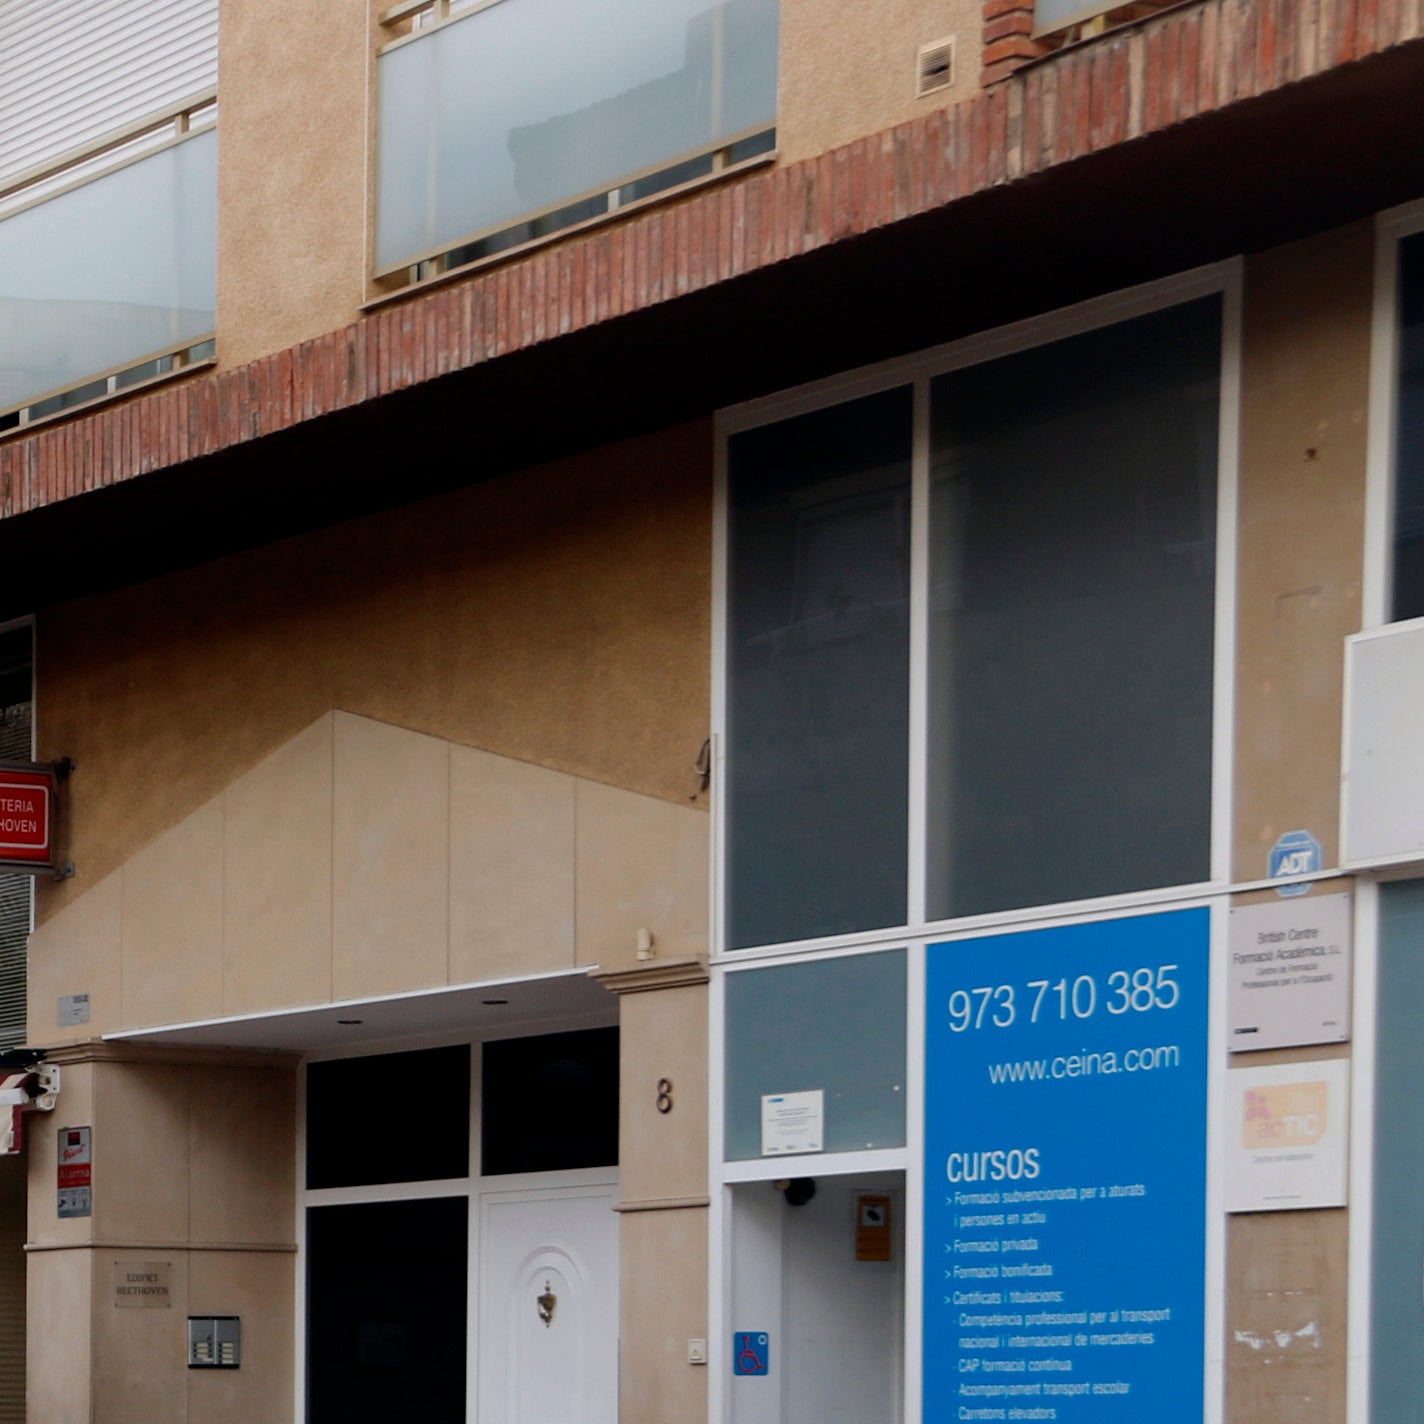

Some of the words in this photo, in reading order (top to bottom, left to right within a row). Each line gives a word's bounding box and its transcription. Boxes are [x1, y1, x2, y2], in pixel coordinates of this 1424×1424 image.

[1275, 850, 1312, 876] ADT
[948, 984, 1016, 1032] 973
[1027, 974, 1096, 1023] 710
[1106, 964, 1180, 1015] 385
[989, 1044, 1180, 1084] www.ceina.com
[657, 1078, 673, 1114] 8
[947, 1147, 1040, 1182] cursos
[954, 1190, 999, 1205] Formació
[1002, 1187, 1077, 1203] subvencionada
[1080, 1188, 1096, 1201] per
[1099, 1187, 1106, 1197] a
[1109, 1184, 1145, 1197] aturats
[960, 1214, 1004, 1229] persones
[1007, 1214, 1019, 1224] en
[1022, 1211, 1046, 1224] actiu
[954, 1238, 999, 1252] Formació
[1002, 1238, 1038, 1254] privada
[126, 1273, 158, 1283] EDIFICI
[953, 1264, 999, 1278] Formació
[1002, 1263, 1052, 1277] bonificada
[116, 1286, 169, 1295] BEETHOVEN
[953, 1291, 1002, 1304] Certificats
[1025, 1311, 1087, 1328] professional
[1090, 1311, 1106, 1325] per
[1121, 1307, 1170, 1324] transport
[959, 1335, 999, 1348] nacional
[1008, 1333, 1072, 1347] internacional
[1074, 1333, 1087, 1345] de
[1090, 1331, 1155, 1345] mercaderies
[959, 1358, 980, 1372] CAP
[959, 1383, 1041, 1398] Acompanyament
[1043, 1382, 1090, 1396] transport
[1092, 1381, 1130, 1394] escolar
[959, 1405, 1005, 1420] Carretons
[1008, 1406, 1056, 1420] elevadors
